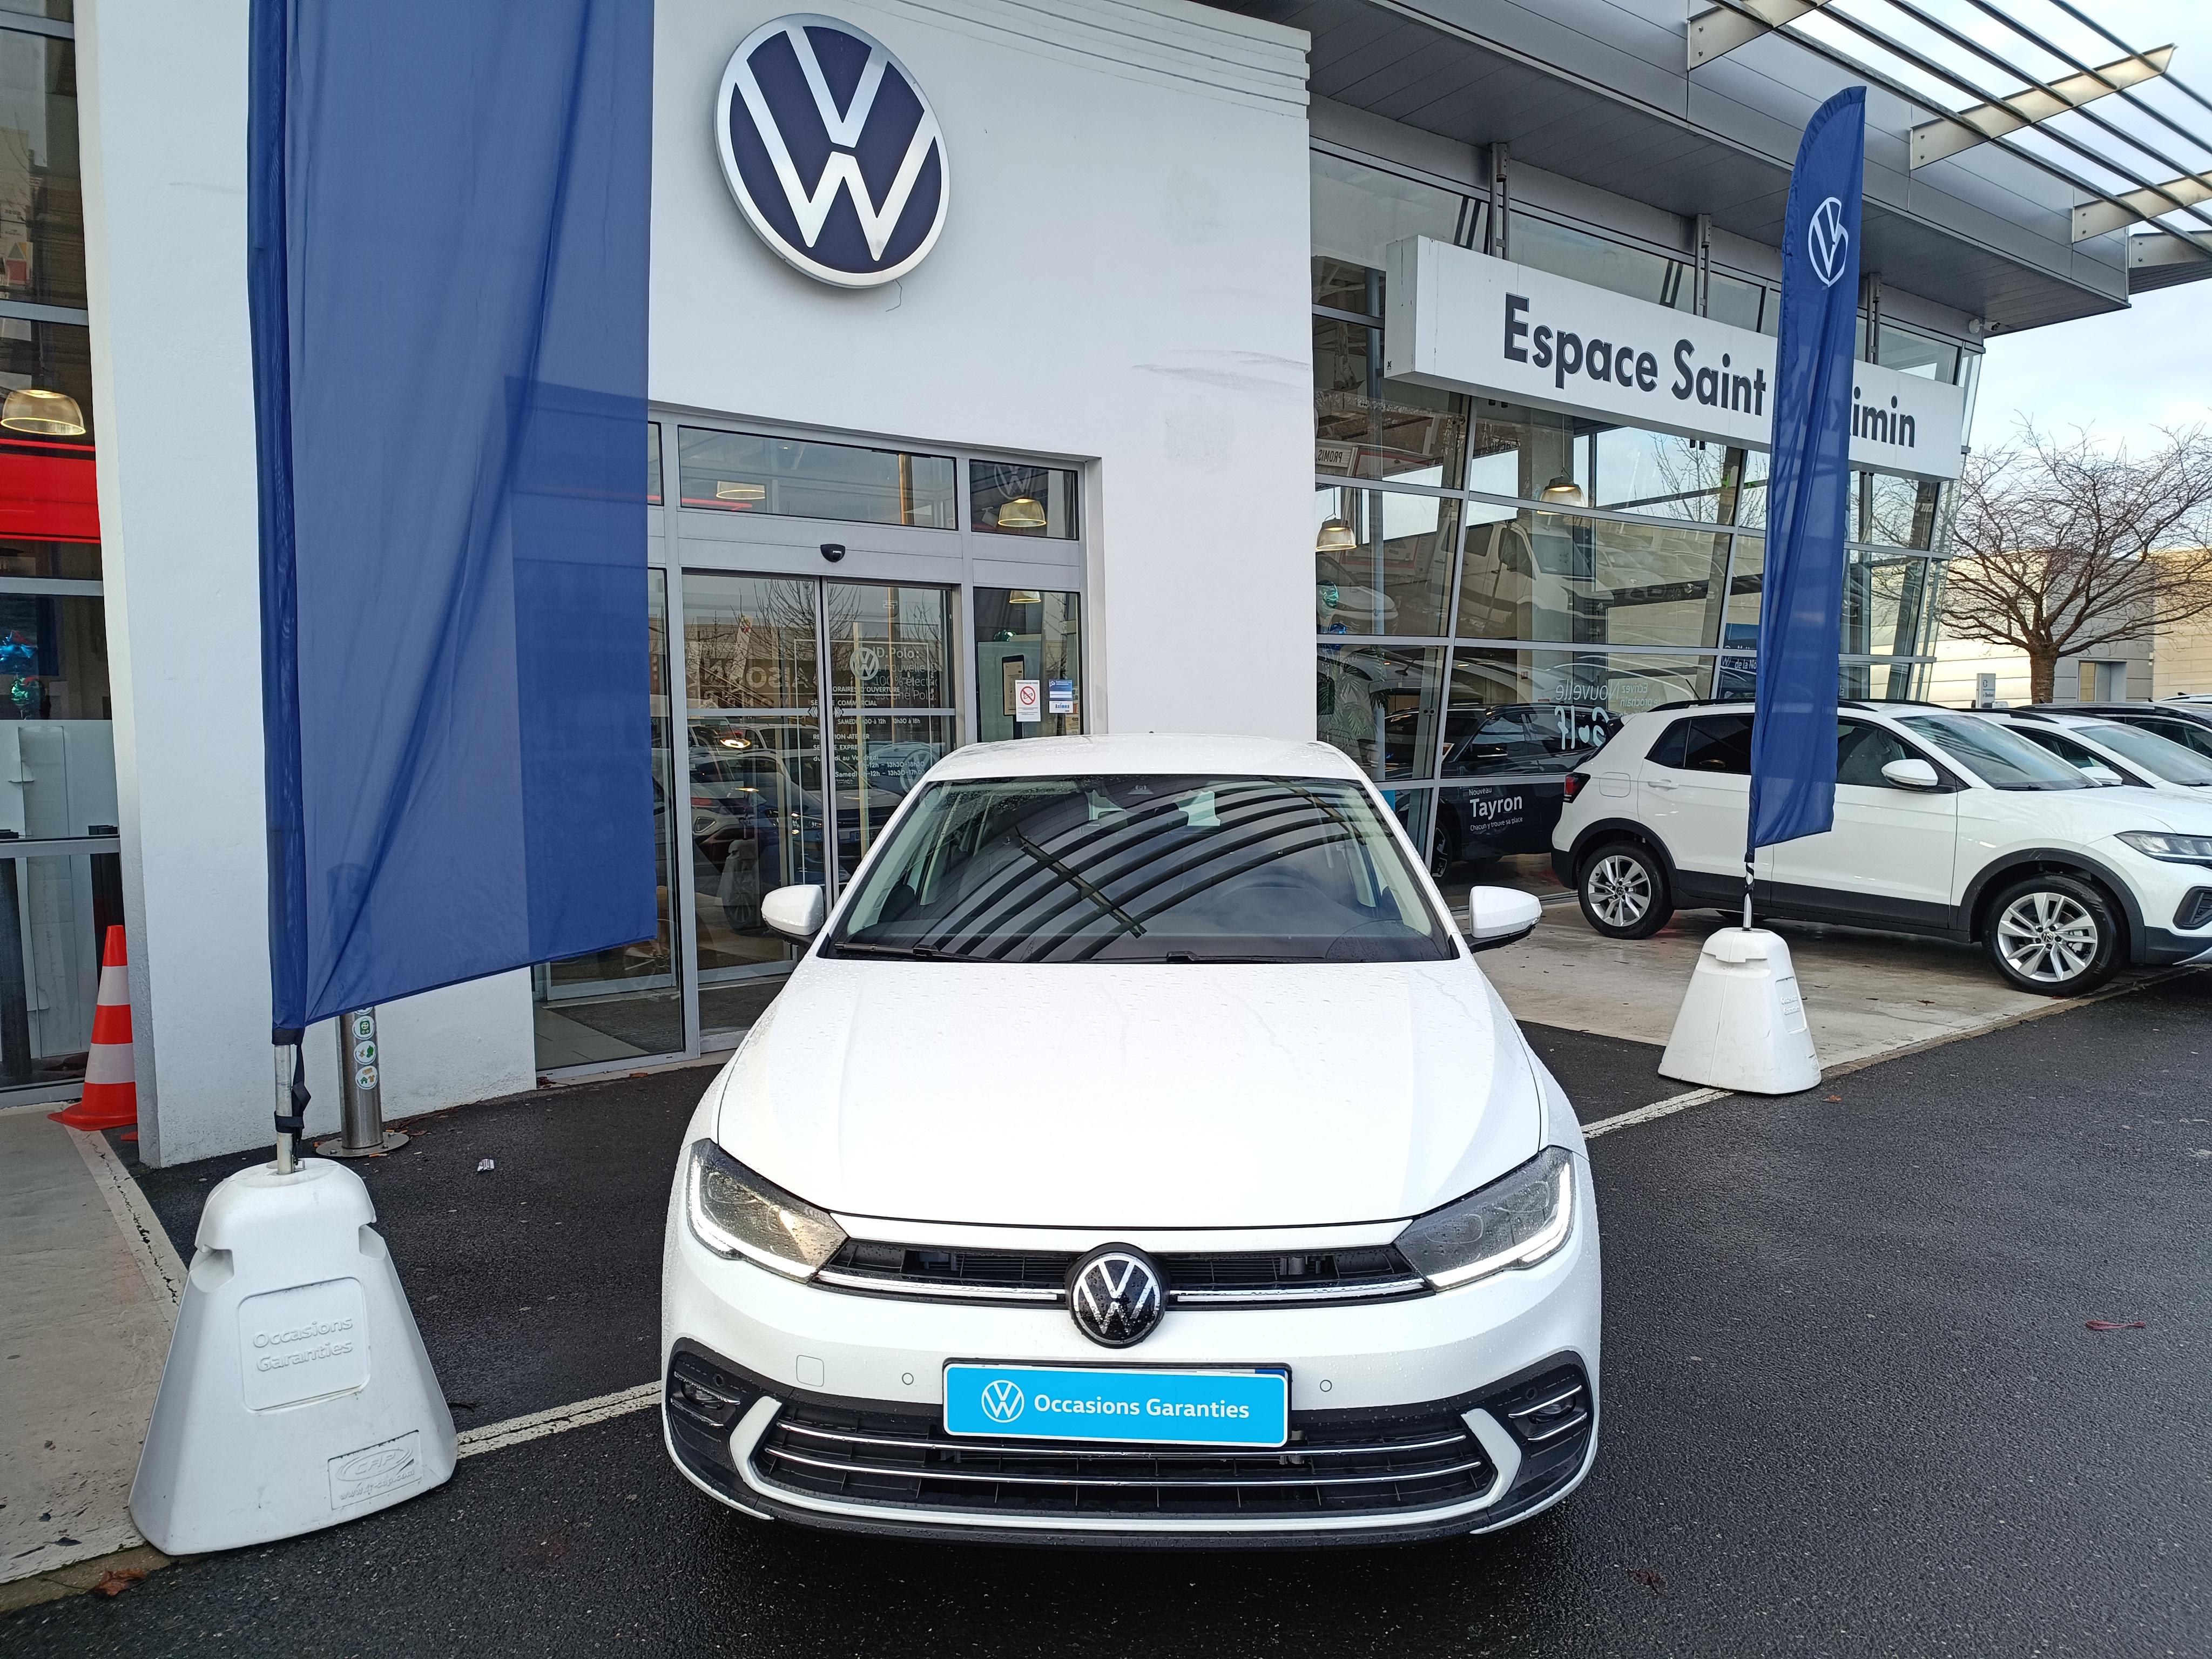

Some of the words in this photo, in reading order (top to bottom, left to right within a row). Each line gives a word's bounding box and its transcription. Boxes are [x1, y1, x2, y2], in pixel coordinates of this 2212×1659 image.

[1504, 292, 1658, 393] Espace
[1671, 339, 1766, 416] Saint
[1850, 386, 1916, 448] imin
[885, 663, 925, 673] nouvelle
[1469, 787, 1492, 796] Nouveau
[1469, 796, 1523, 820] Tayron
[1512, 817, 1523, 825] place
[253, 1317, 353, 1348] Occasions
[256, 1340, 353, 1372] Garanties
[1034, 1394, 1140, 1416] Occasions
[1146, 1398, 1250, 1419] Garanties
[354, 1451, 397, 1475] CAP
